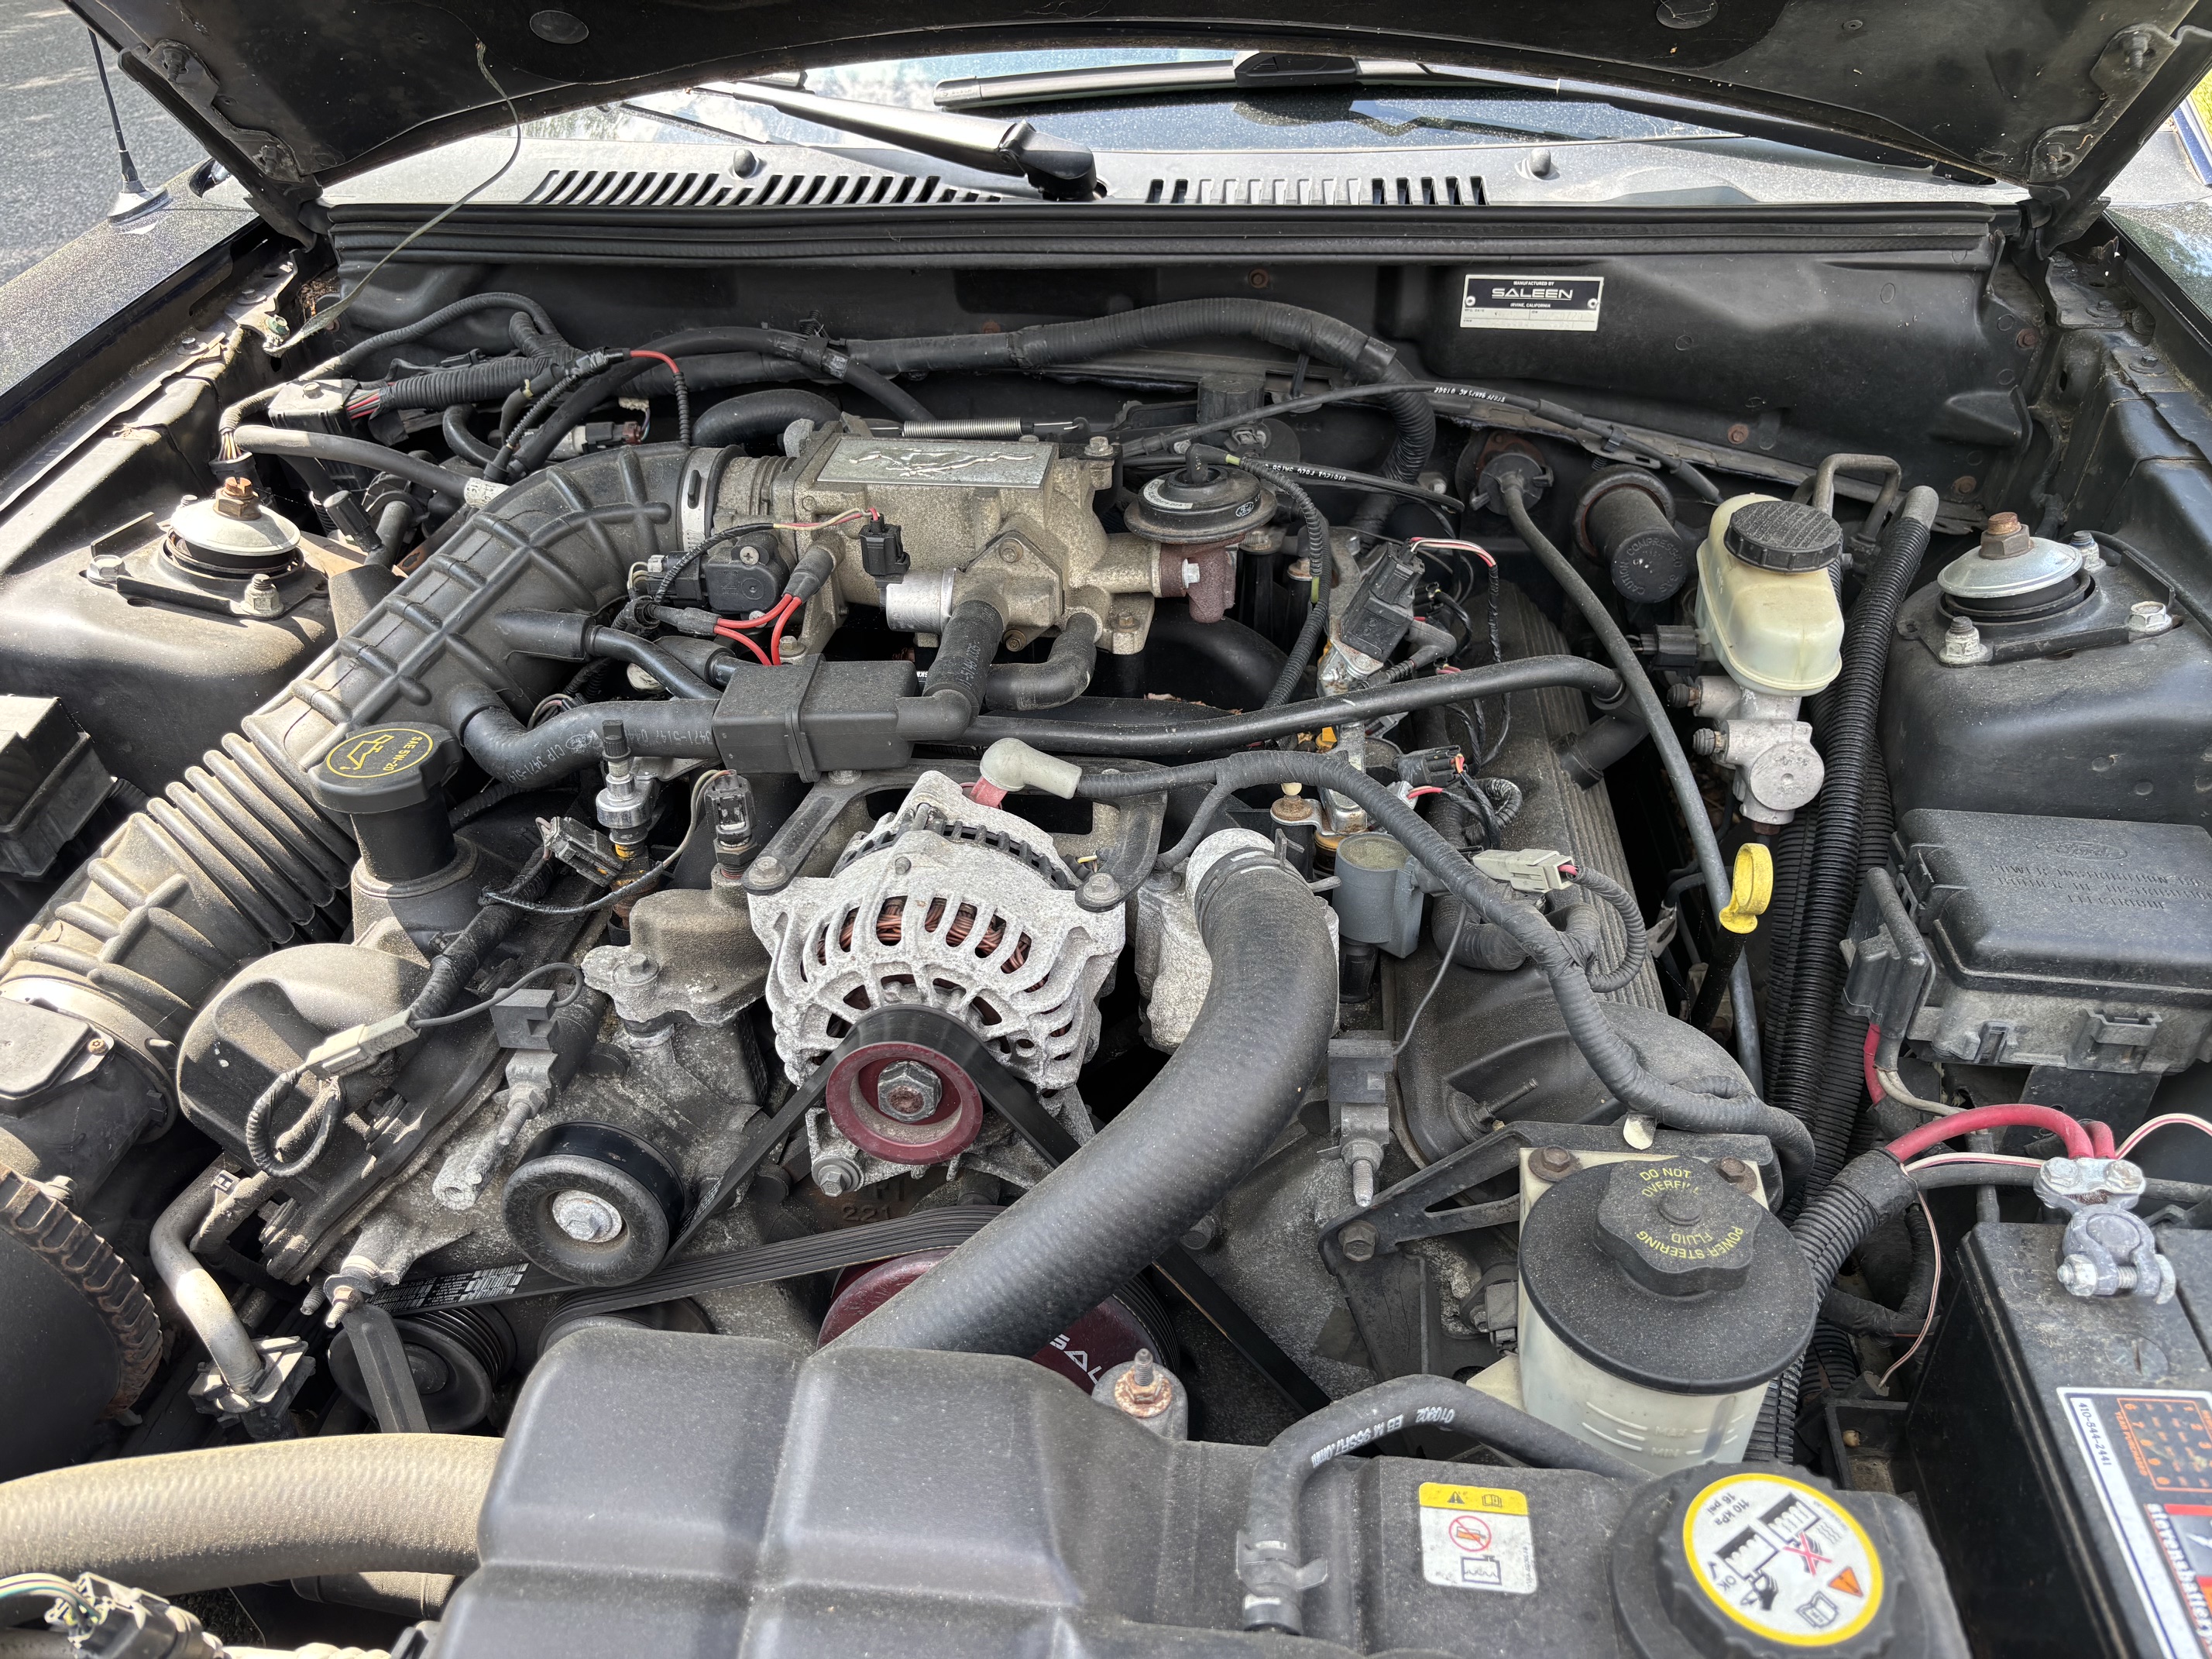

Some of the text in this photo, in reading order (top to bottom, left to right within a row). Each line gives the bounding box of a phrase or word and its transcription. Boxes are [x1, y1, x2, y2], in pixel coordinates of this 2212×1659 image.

[1491, 287, 1574, 300] SALEEN
[1626, 538, 1683, 568] COMPRESSED
[1619, 561, 1646, 596] CAUTION
[1658, 574, 1680, 593] GAS
[383, 736, 423, 771] SAE 5W-20
[548, 744, 566, 762] CIP
[1990, 864, 2208, 887] POWER DISTRIBUTION BOX
[1639, 1167, 1692, 1181] DO NOT
[1641, 1180, 1700, 1198] OVERFIL
[1636, 1225, 1744, 1260] POWER STEERING
[1671, 1231, 1713, 1245] FLUID
[2078, 1403, 2112, 1466] 410-844-2441
[1650, 1447, 1680, 1458] MIN
[1706, 1492, 1736, 1516] 16 psi
[1713, 1498, 1750, 1527] 110 kPa
[1716, 1575, 1737, 1592] OK
